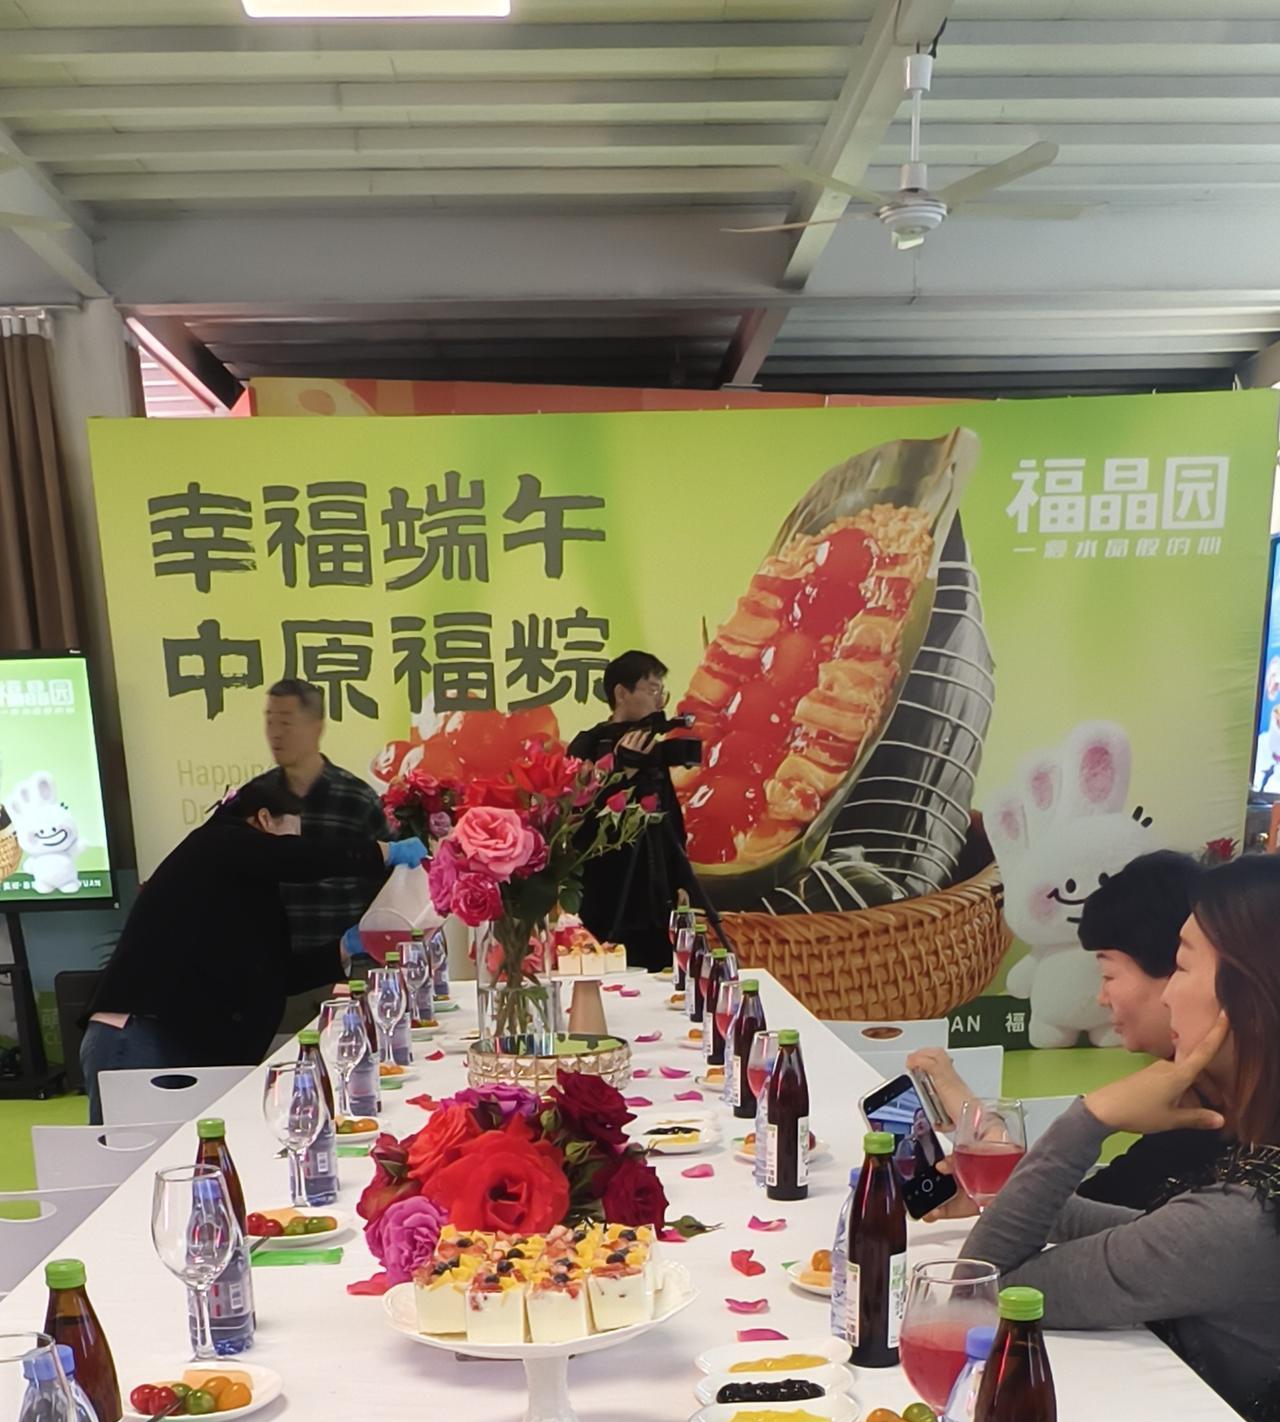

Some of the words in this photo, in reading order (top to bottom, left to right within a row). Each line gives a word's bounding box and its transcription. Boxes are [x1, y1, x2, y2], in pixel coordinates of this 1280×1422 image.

[147, 470, 607, 594] 幸福端午
[1005, 456, 1230, 533] 福晶园
[162, 607, 610, 722] 中原福粽
